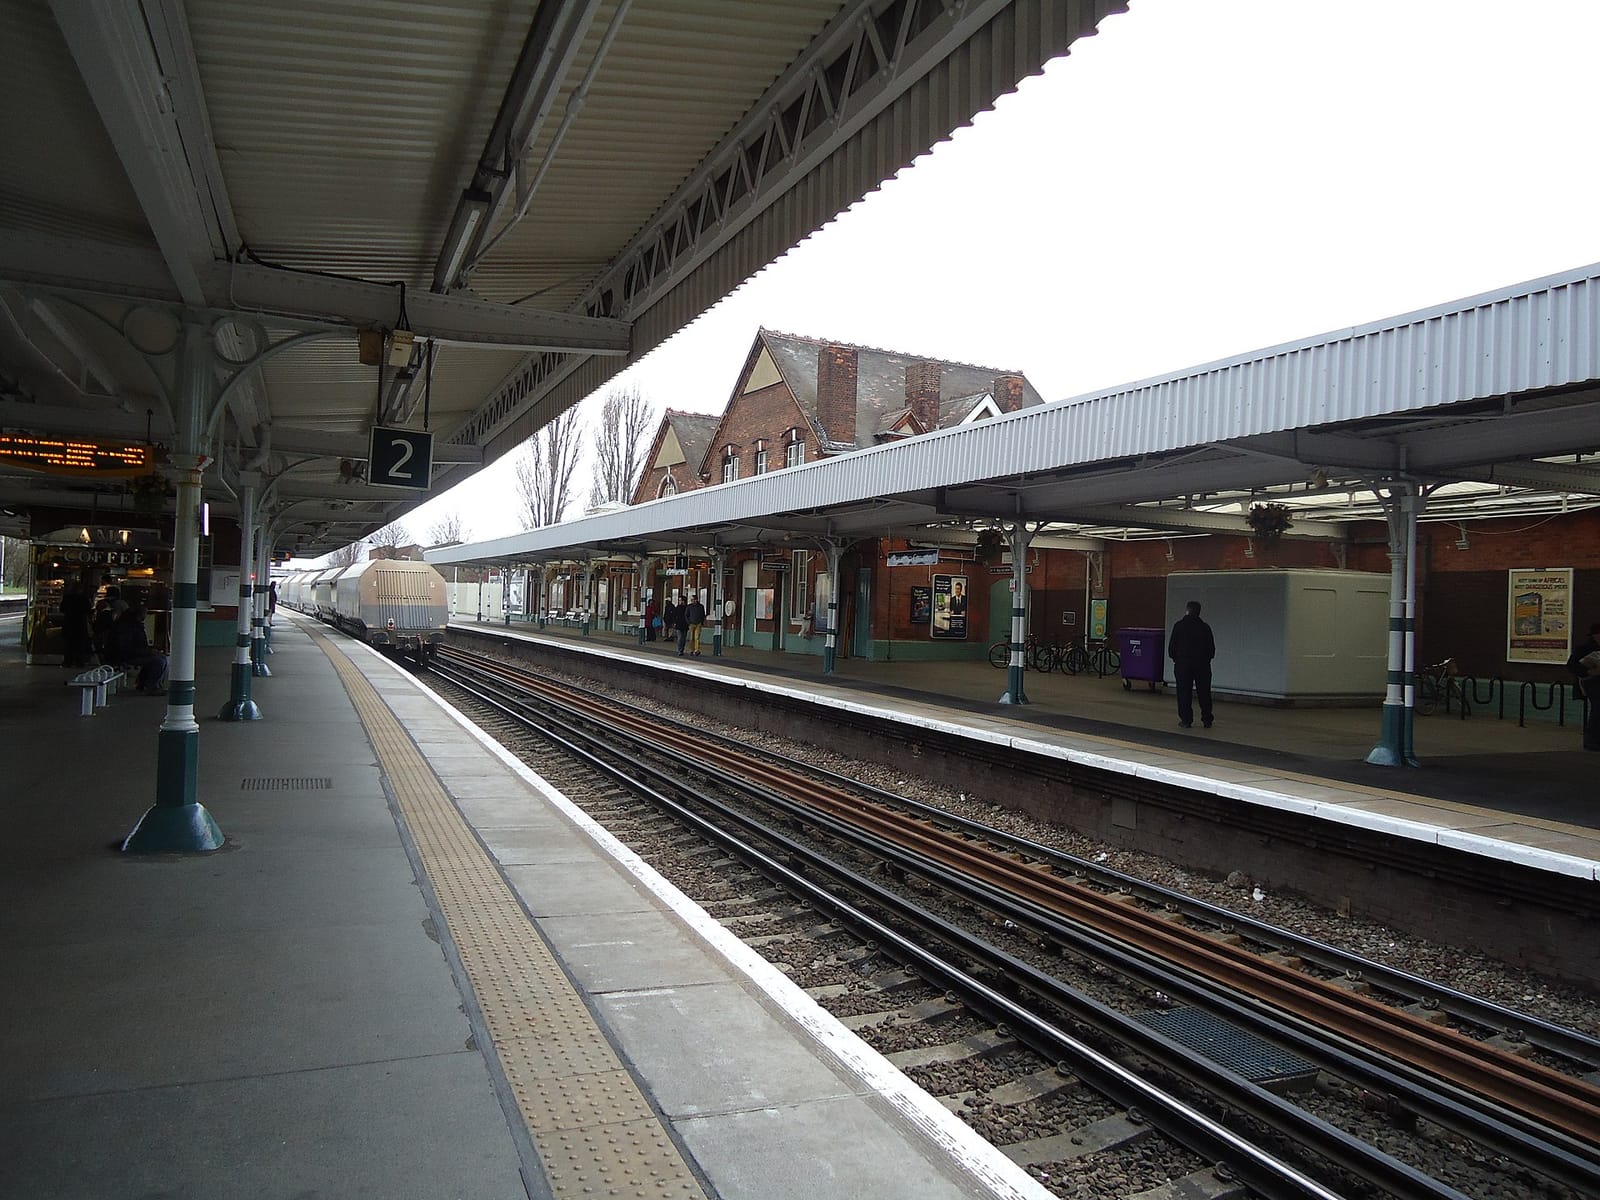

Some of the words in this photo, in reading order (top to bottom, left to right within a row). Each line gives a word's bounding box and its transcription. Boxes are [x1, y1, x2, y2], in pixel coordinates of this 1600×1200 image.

[388, 438, 413, 479] 2
[79, 527, 132, 545] AMT
[64, 551, 145, 565] COFFEE
